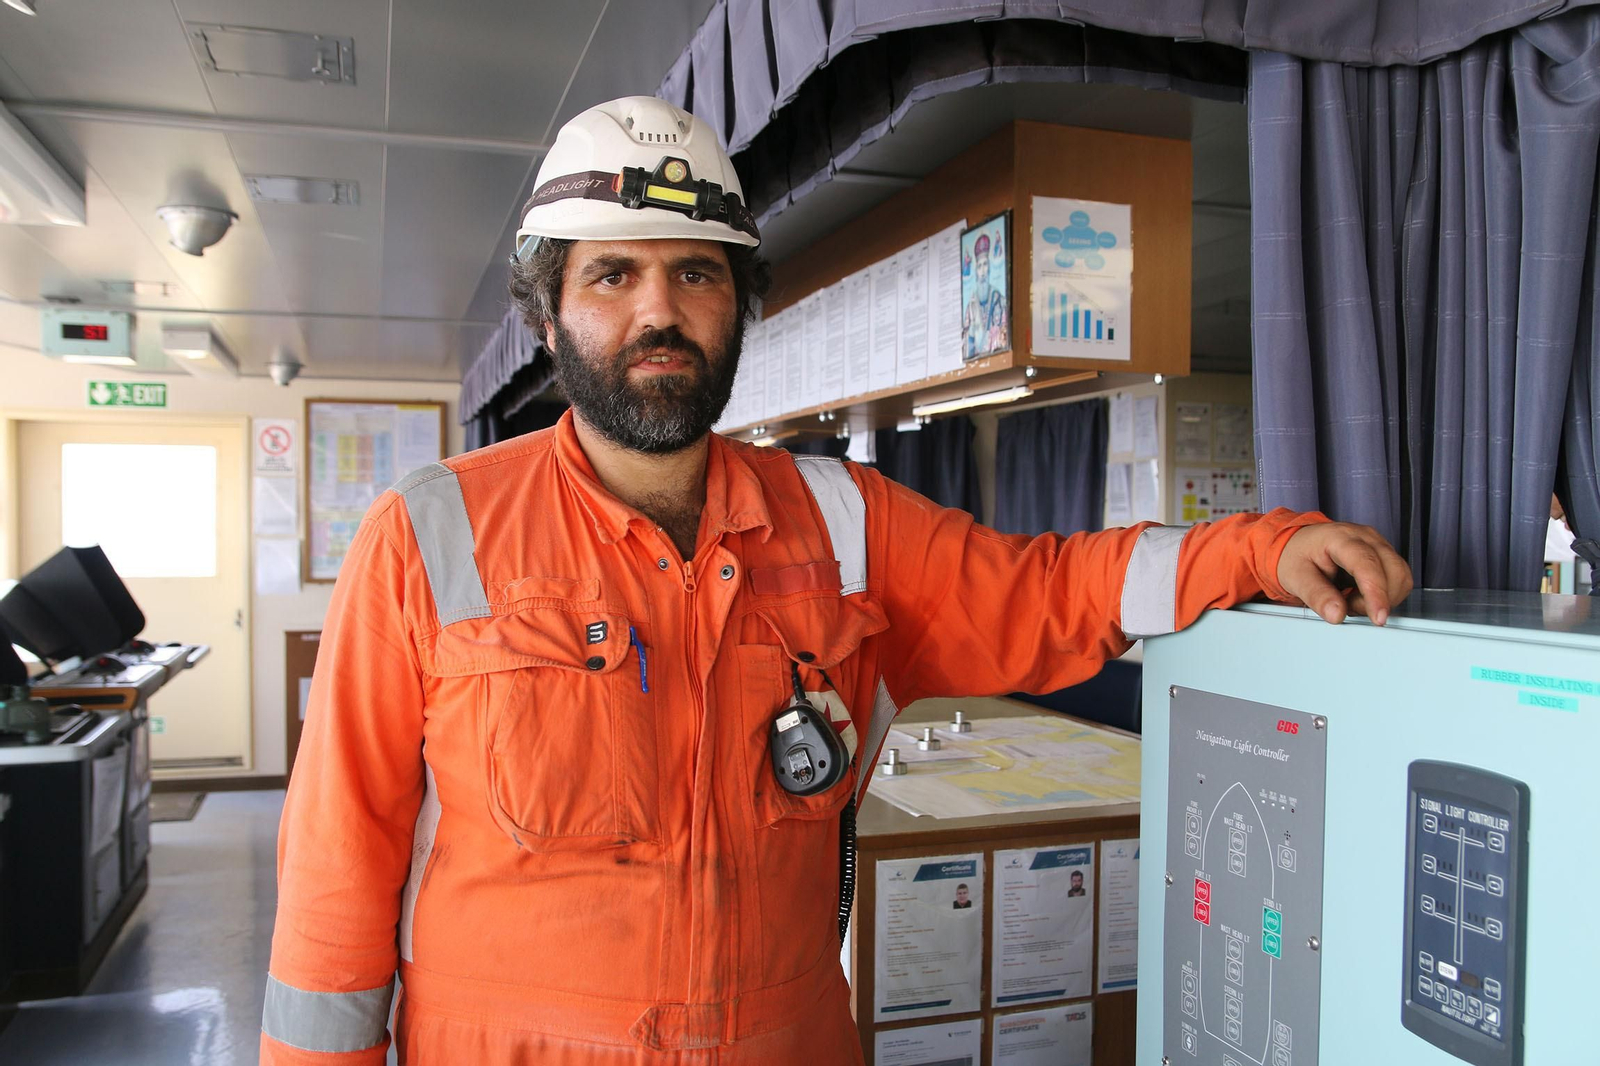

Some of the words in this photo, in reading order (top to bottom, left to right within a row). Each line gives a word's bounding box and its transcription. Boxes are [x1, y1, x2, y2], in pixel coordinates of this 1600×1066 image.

[536, 178, 604, 199] HEADLIGHT
[133, 384, 166, 405] EXIT
[1481, 668, 1520, 684] RUBBER
[1525, 675, 1593, 693] INSULATING
[1530, 694, 1565, 709] INSIDE
[1276, 719, 1300, 735] CDS
[1195, 729, 1232, 747] Navigation
[1233, 739, 1252, 754] Light
[1253, 744, 1290, 762] Controller
[1233, 812, 1244, 822] FORE
[1420, 798, 1443, 814] SIGNAL
[1445, 804, 1465, 820] LIGHT
[1468, 811, 1509, 832] CONTROLLER
[1235, 821, 1246, 831] HEAD
[941, 864, 972, 872] Certificate
[1232, 928, 1243, 939] HEAD
[999, 1024, 1040, 1035] CERTIFICATE
